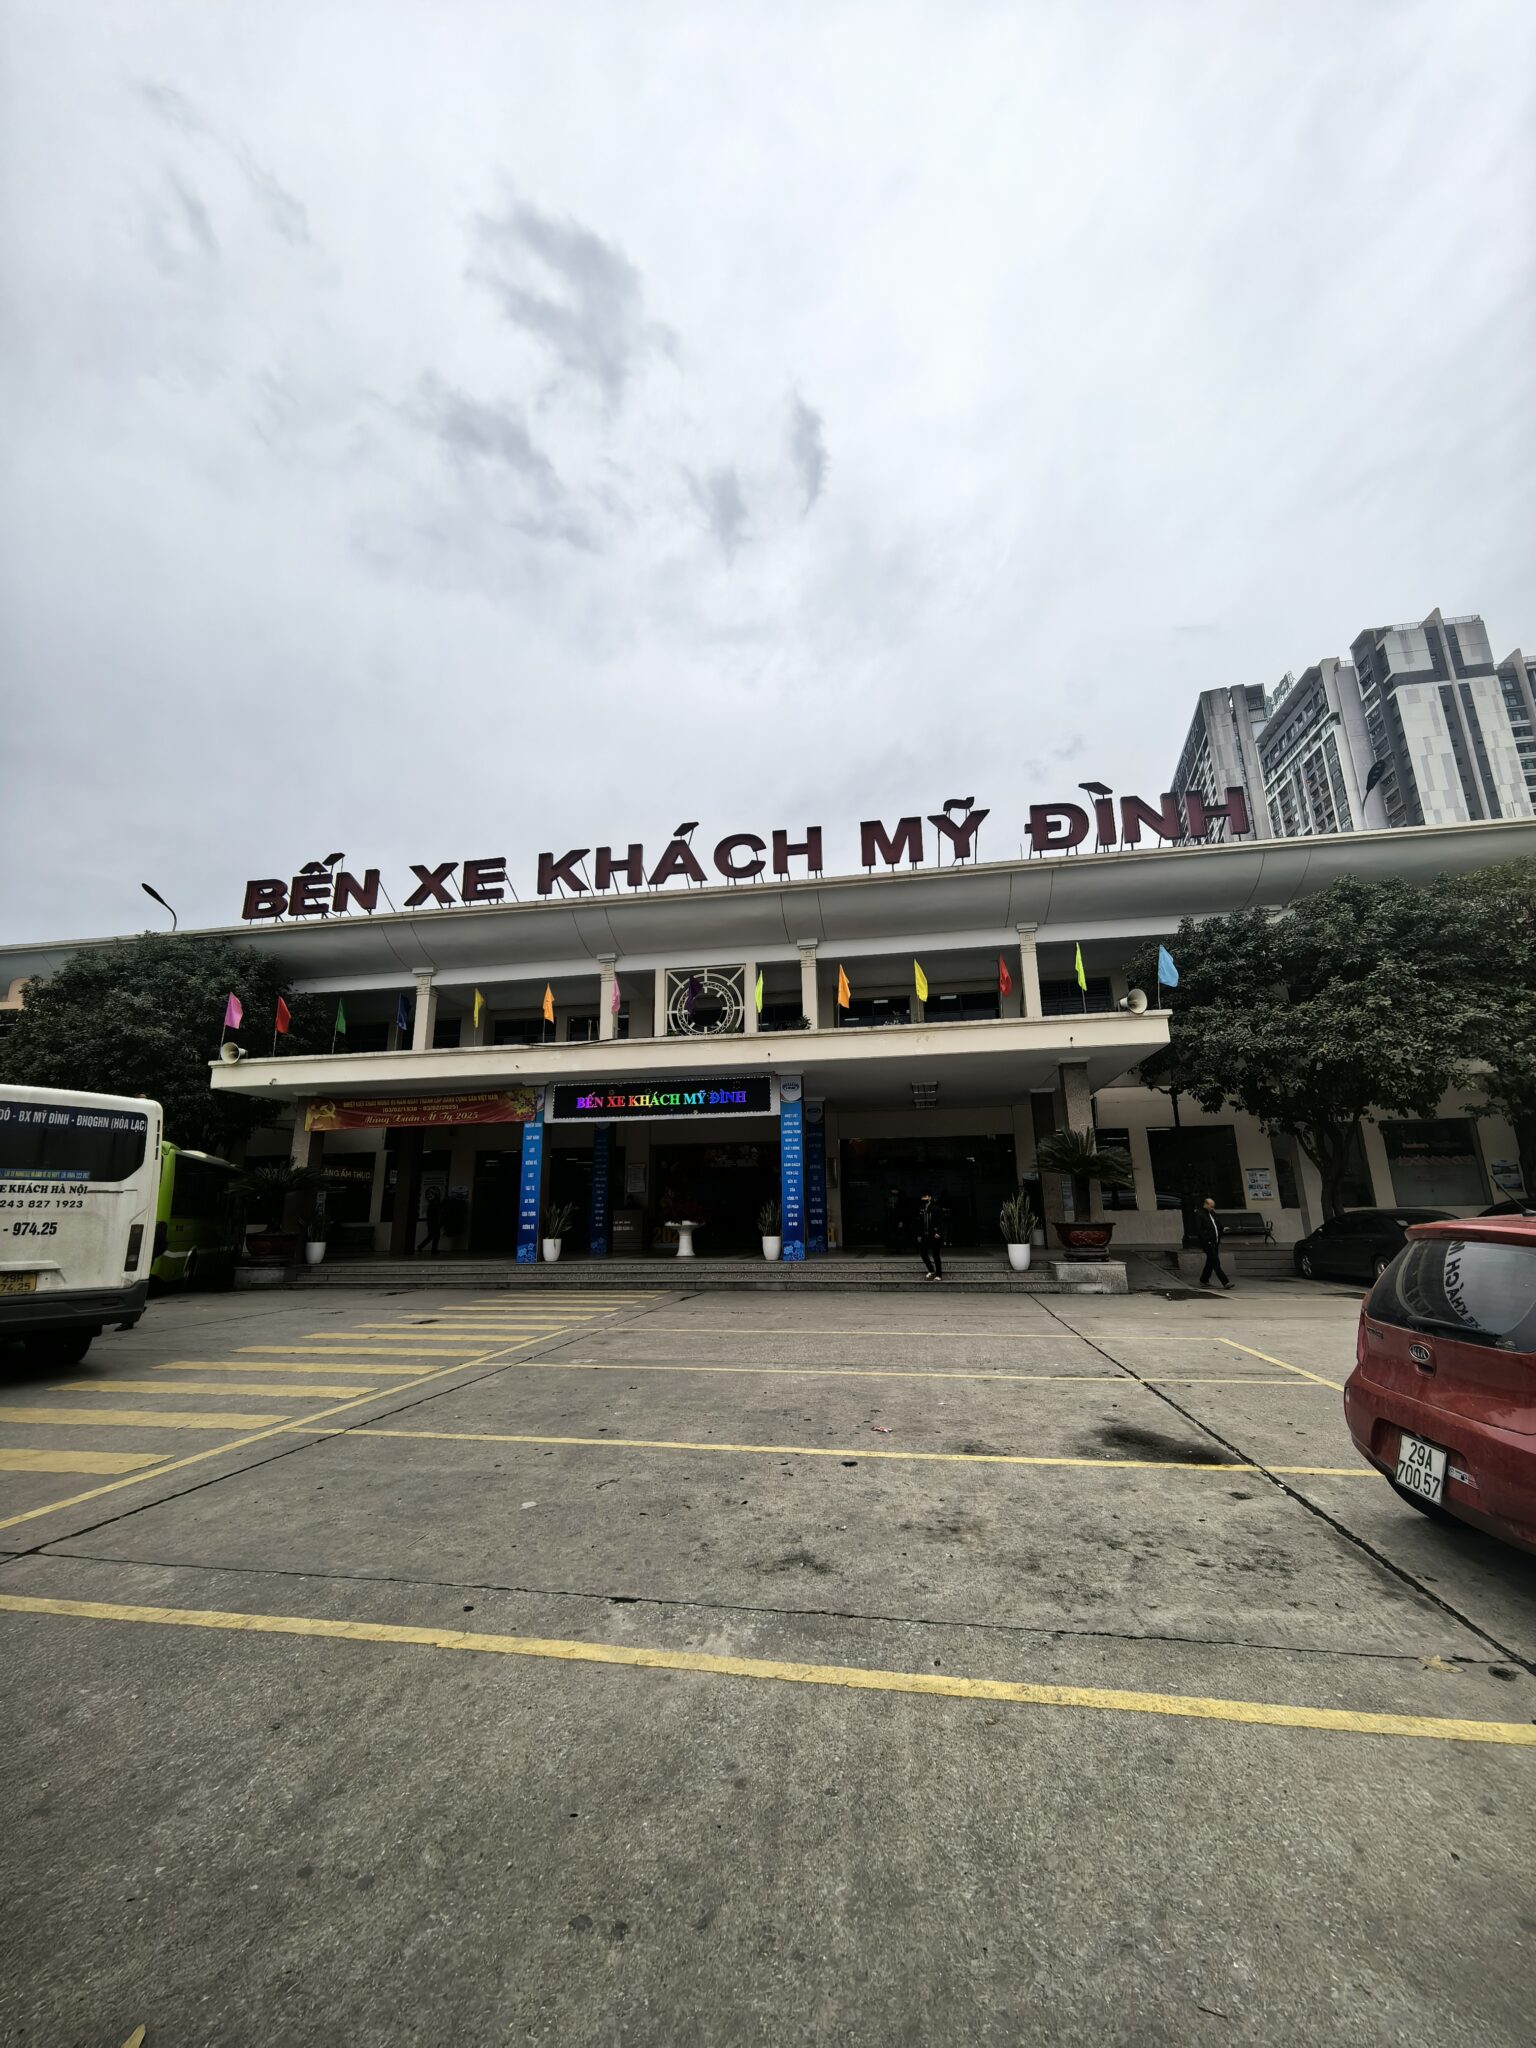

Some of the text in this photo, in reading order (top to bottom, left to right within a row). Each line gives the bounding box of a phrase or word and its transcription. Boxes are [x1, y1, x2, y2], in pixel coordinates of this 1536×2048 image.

[241, 781, 1249, 920] BẾN XE KHÁCH MỸ ĐÌNH
[576, 1088, 747, 1109] BẾN XE KHÁCH MỸ ĐÌNH
[18, 1110, 31, 1122] BX
[32, 1110, 48, 1123] MỸ
[48, 1110, 70, 1125] ĐÌNH
[76, 1114, 109, 1128] ĐHQGHN
[8, 1182, 49, 1193] KHÁCH
[50, 1183, 66, 1194] HÀ
[68, 1183, 88, 1196] NỘI
[28, 1200, 50, 1208] 827
[56, 1200, 83, 1208] 1923
[12, 1222, 58, 1236] 974.25
[1411, 1345, 1428, 1359] KIA
[1408, 1441, 1432, 1472] 29A
[1398, 1460, 1441, 1499] 700.57
